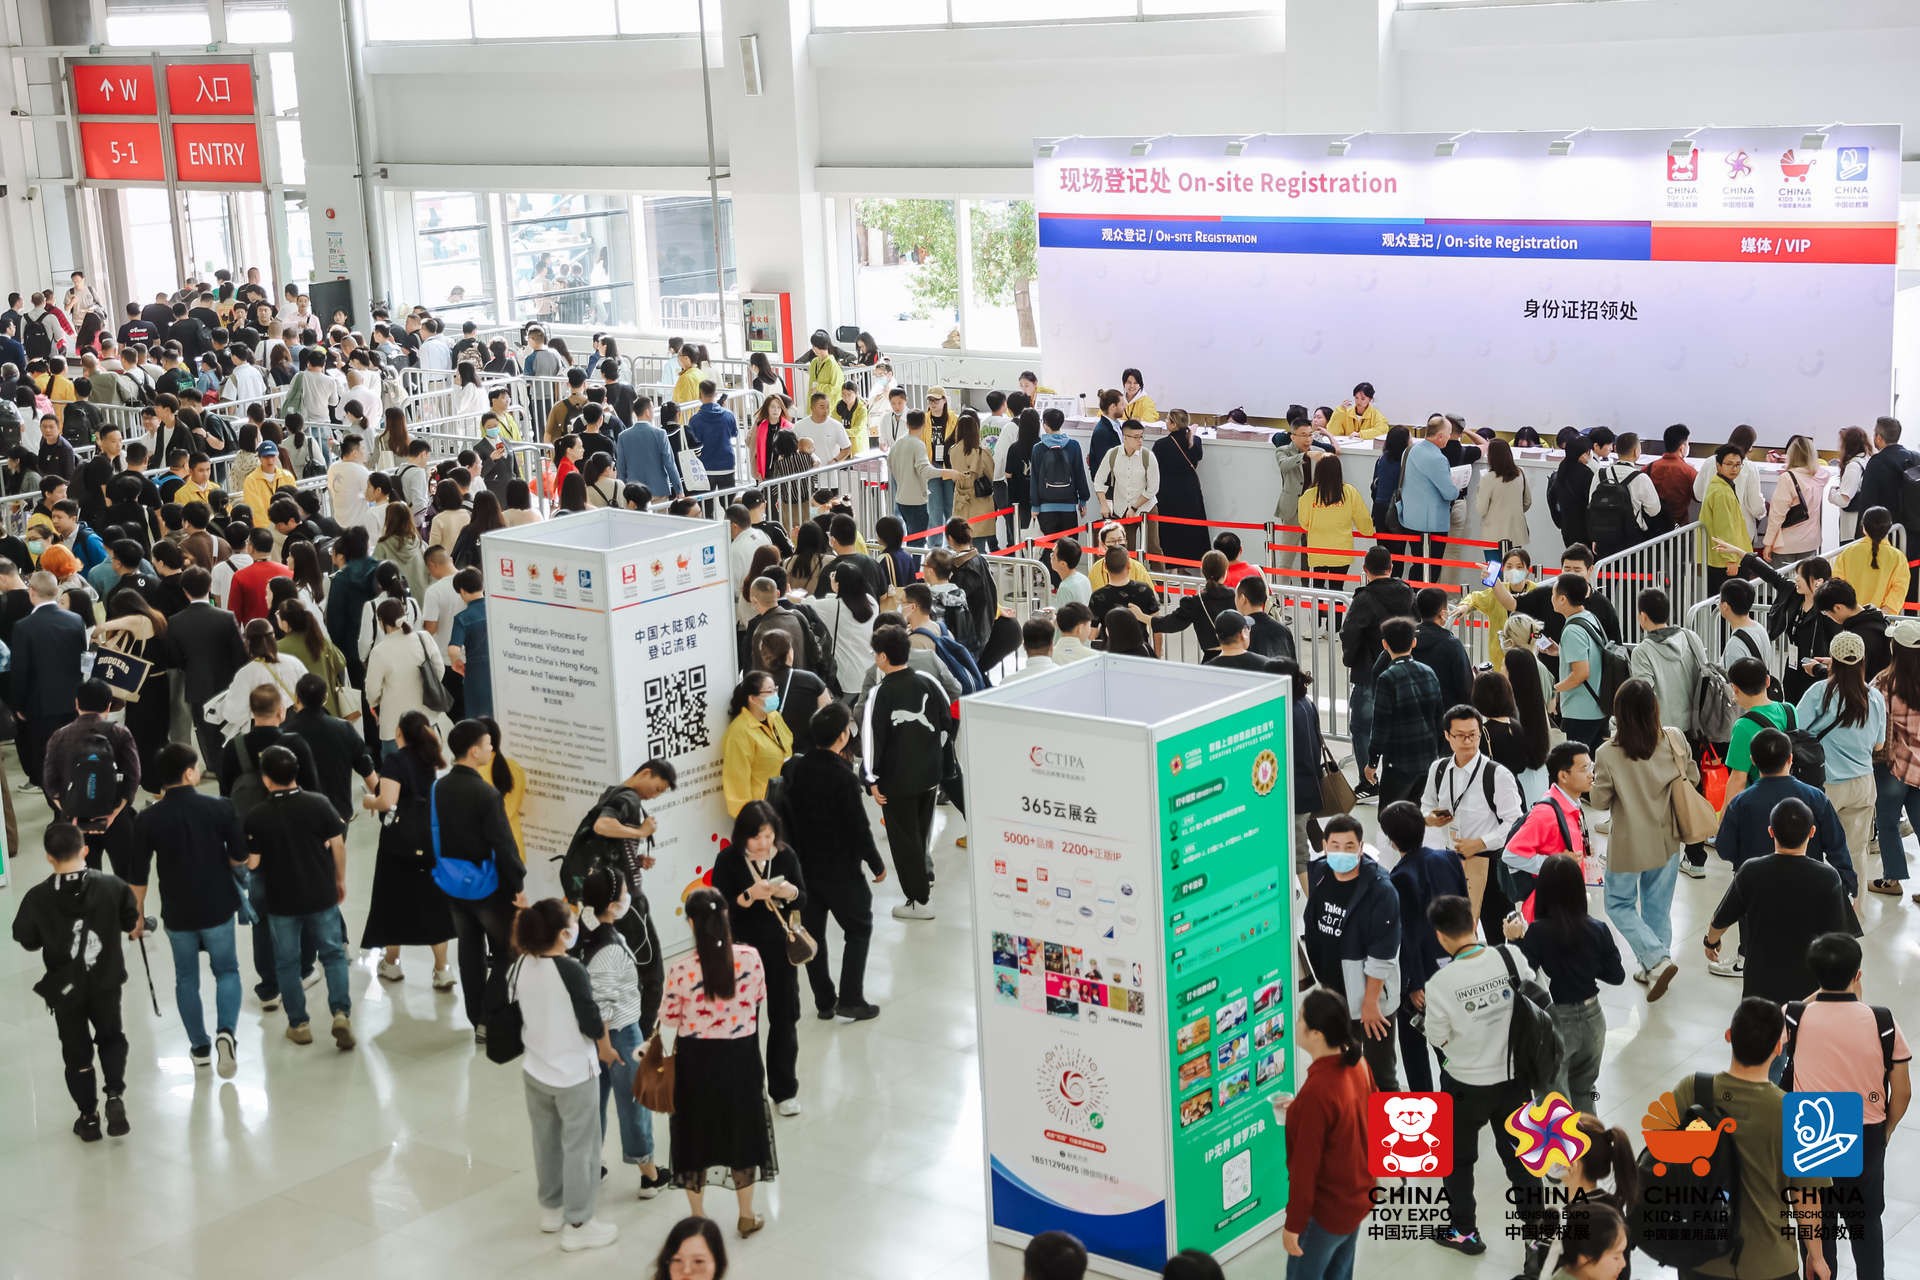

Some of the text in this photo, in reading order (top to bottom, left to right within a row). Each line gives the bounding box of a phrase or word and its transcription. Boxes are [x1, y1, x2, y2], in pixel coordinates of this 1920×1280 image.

[119, 78, 137, 101] W
[196, 75, 231, 102] 入口
[110, 141, 138, 164] 5-1
[188, 142, 245, 166] ENTRY
[1059, 166, 1398, 199] 现场登记处 On-site Registration
[1666, 186, 1697, 195] CHINA
[1722, 186, 1754, 195] CHINA
[1778, 187, 1812, 196] CHINA
[1834, 186, 1869, 195] CHINA
[1101, 228, 1147, 242] 观众登记
[1381, 233, 1434, 248] 观众登记
[1445, 234, 1492, 249] On-site
[1495, 236, 1578, 252] Registration
[1740, 236, 1772, 254] 媒体
[1785, 239, 1811, 253] VIP
[1523, 298, 1639, 321] 身份证招领处
[509, 623, 588, 641] Registration Process For
[635, 612, 708, 644] 中国大陆观众
[514, 638, 585, 656] Overseas Visitors and
[648, 634, 697, 660] 登记流程
[97, 656, 130, 675] DODGERS
[502, 650, 526, 661] Visitors
[535, 656, 559, 667] China's
[560, 661, 578, 672] Hong
[530, 669, 543, 679] And
[544, 671, 568, 682] Taiwan
[1045, 751, 1085, 769] CTIPA
[1021, 796, 1098, 824] 365云展会
[1003, 831, 1054, 850] 5000+品牌
[1323, 901, 1342, 915] Take
